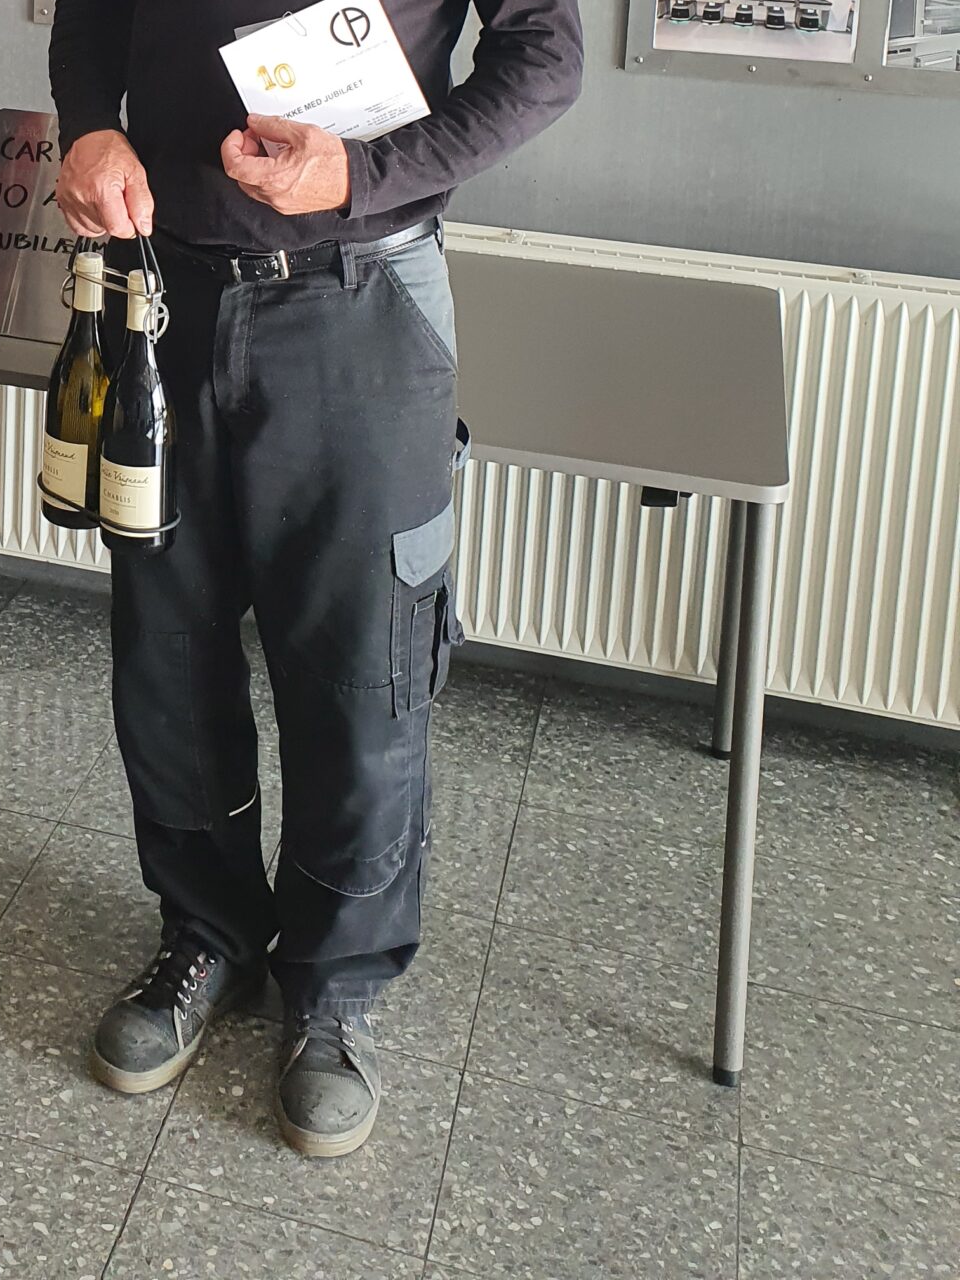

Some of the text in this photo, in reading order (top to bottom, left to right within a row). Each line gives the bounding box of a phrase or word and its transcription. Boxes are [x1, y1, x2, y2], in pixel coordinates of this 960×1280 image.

[256, 62, 296, 91] 10
[305, 99, 322, 111] MED
[324, 79, 364, 102] JUBILÆET
[0, 137, 61, 163] CAR
[103, 488, 131, 504] CHABLIS
